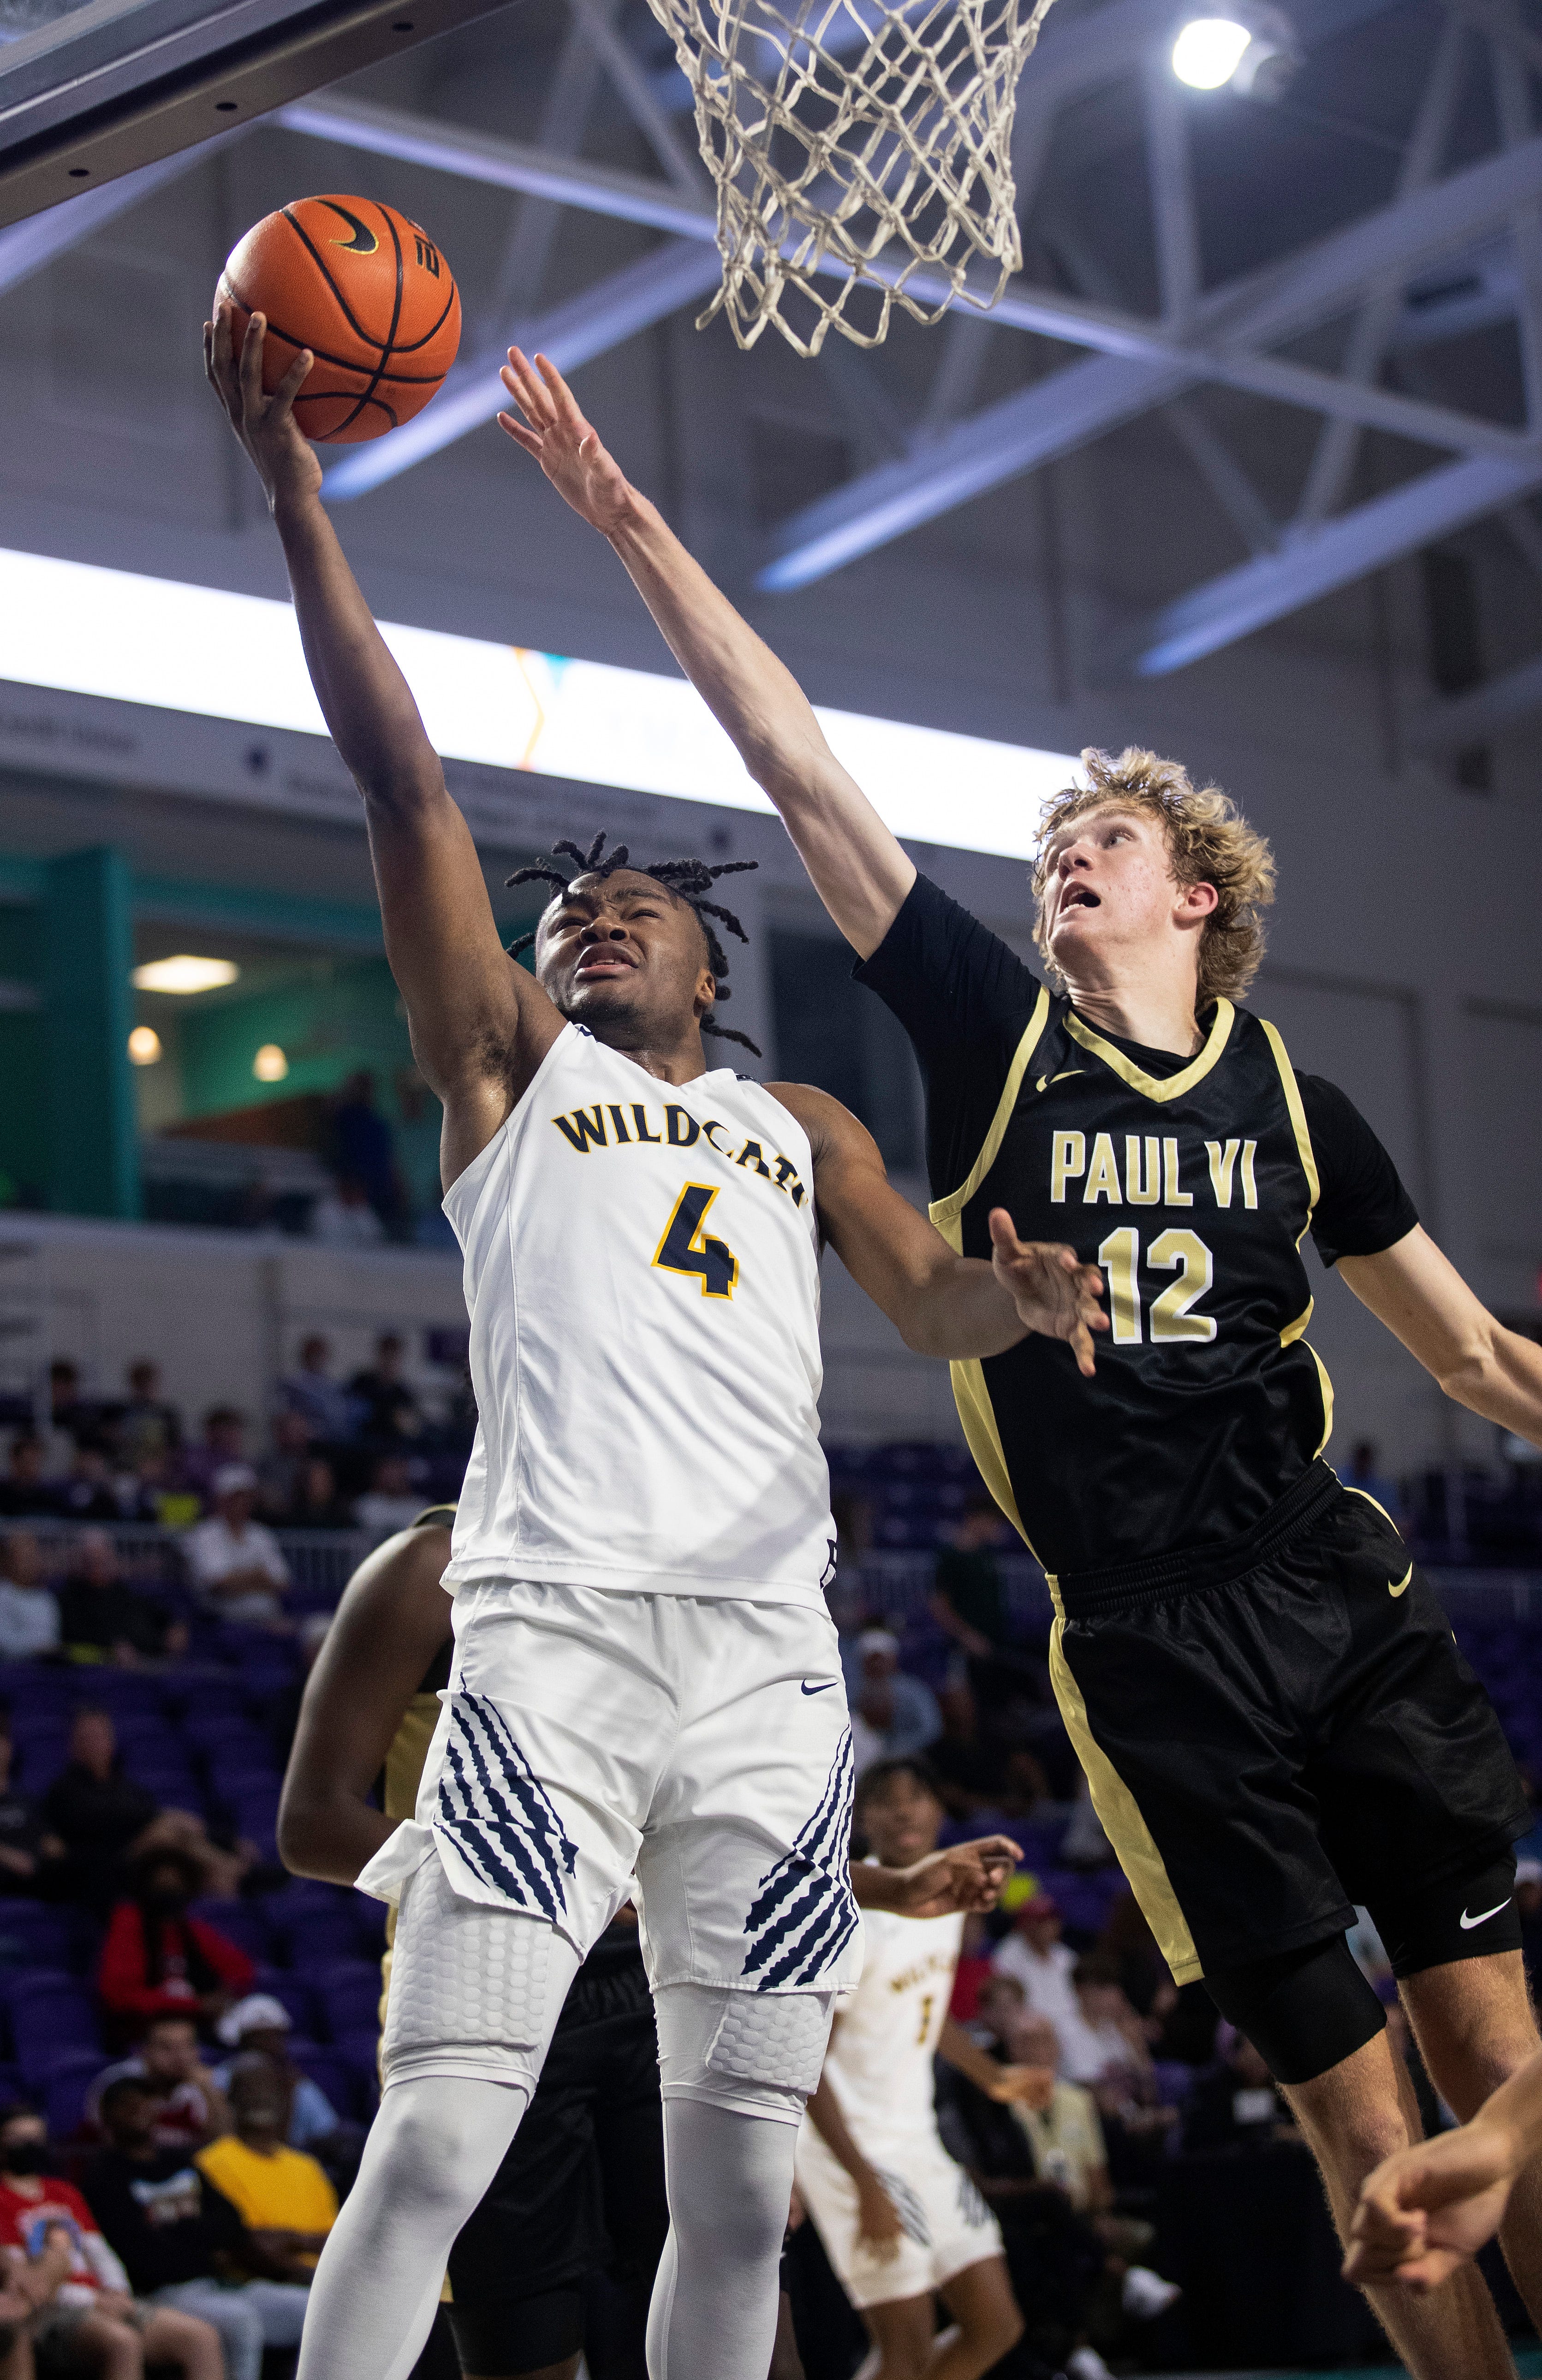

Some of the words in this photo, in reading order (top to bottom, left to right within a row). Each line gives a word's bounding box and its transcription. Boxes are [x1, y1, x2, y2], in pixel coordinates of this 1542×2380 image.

[1051, 1130, 1194, 1206] PAUL
[1204, 1139, 1258, 1210] VI
[650, 1181, 739, 1301] 4
[1098, 1227, 1218, 1345] 12
